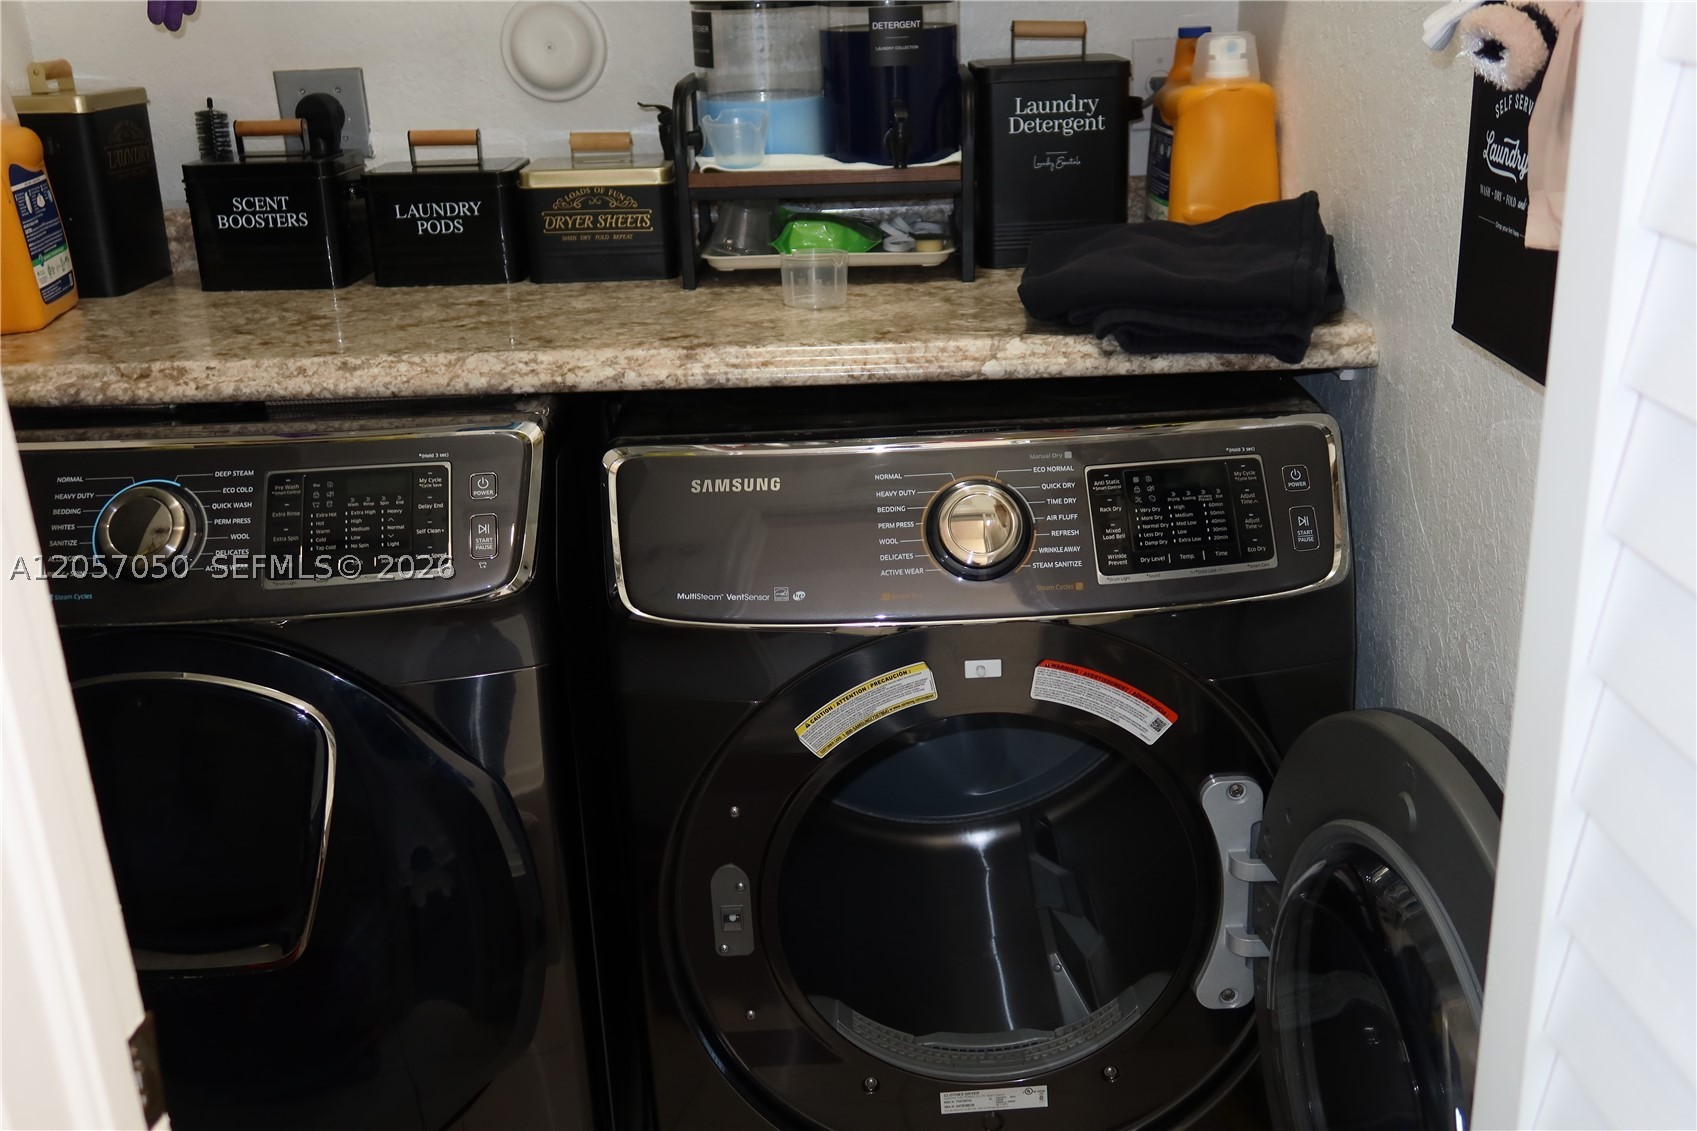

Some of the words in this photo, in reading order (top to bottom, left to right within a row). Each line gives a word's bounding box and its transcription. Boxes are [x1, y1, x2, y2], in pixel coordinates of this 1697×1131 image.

[872, 20, 920, 30] DETERGENT
[1015, 94, 1099, 116] Laundry
[1495, 94, 1513, 119] SELF
[1008, 115, 1105, 136] Detergent
[1483, 130, 1529, 183] Laundry
[564, 187, 591, 202] LOADS
[608, 189, 625, 201] FUN
[232, 196, 289, 212] SCENT
[395, 201, 482, 219] LAUNDRY
[217, 212, 308, 229] BOOSTERS
[417, 219, 464, 235] PODS
[544, 215, 593, 229] DRYER
[597, 213, 651, 228] SHEETS
[1029, 452, 1051, 460] Manual
[1052, 452, 1063, 460] Dry
[691, 477, 781, 494] SAMSUNG
[232, 501, 252, 509] WASH
[880, 553, 914, 561] DELICATES
[1055, 560, 1083, 568] SANITIZE
[1055, 583, 1074, 591] Cycles
[726, 593, 770, 601] VentSensor
[810, 705, 833, 725] CAUTION
[835, 686, 868, 706] ATTENTION
